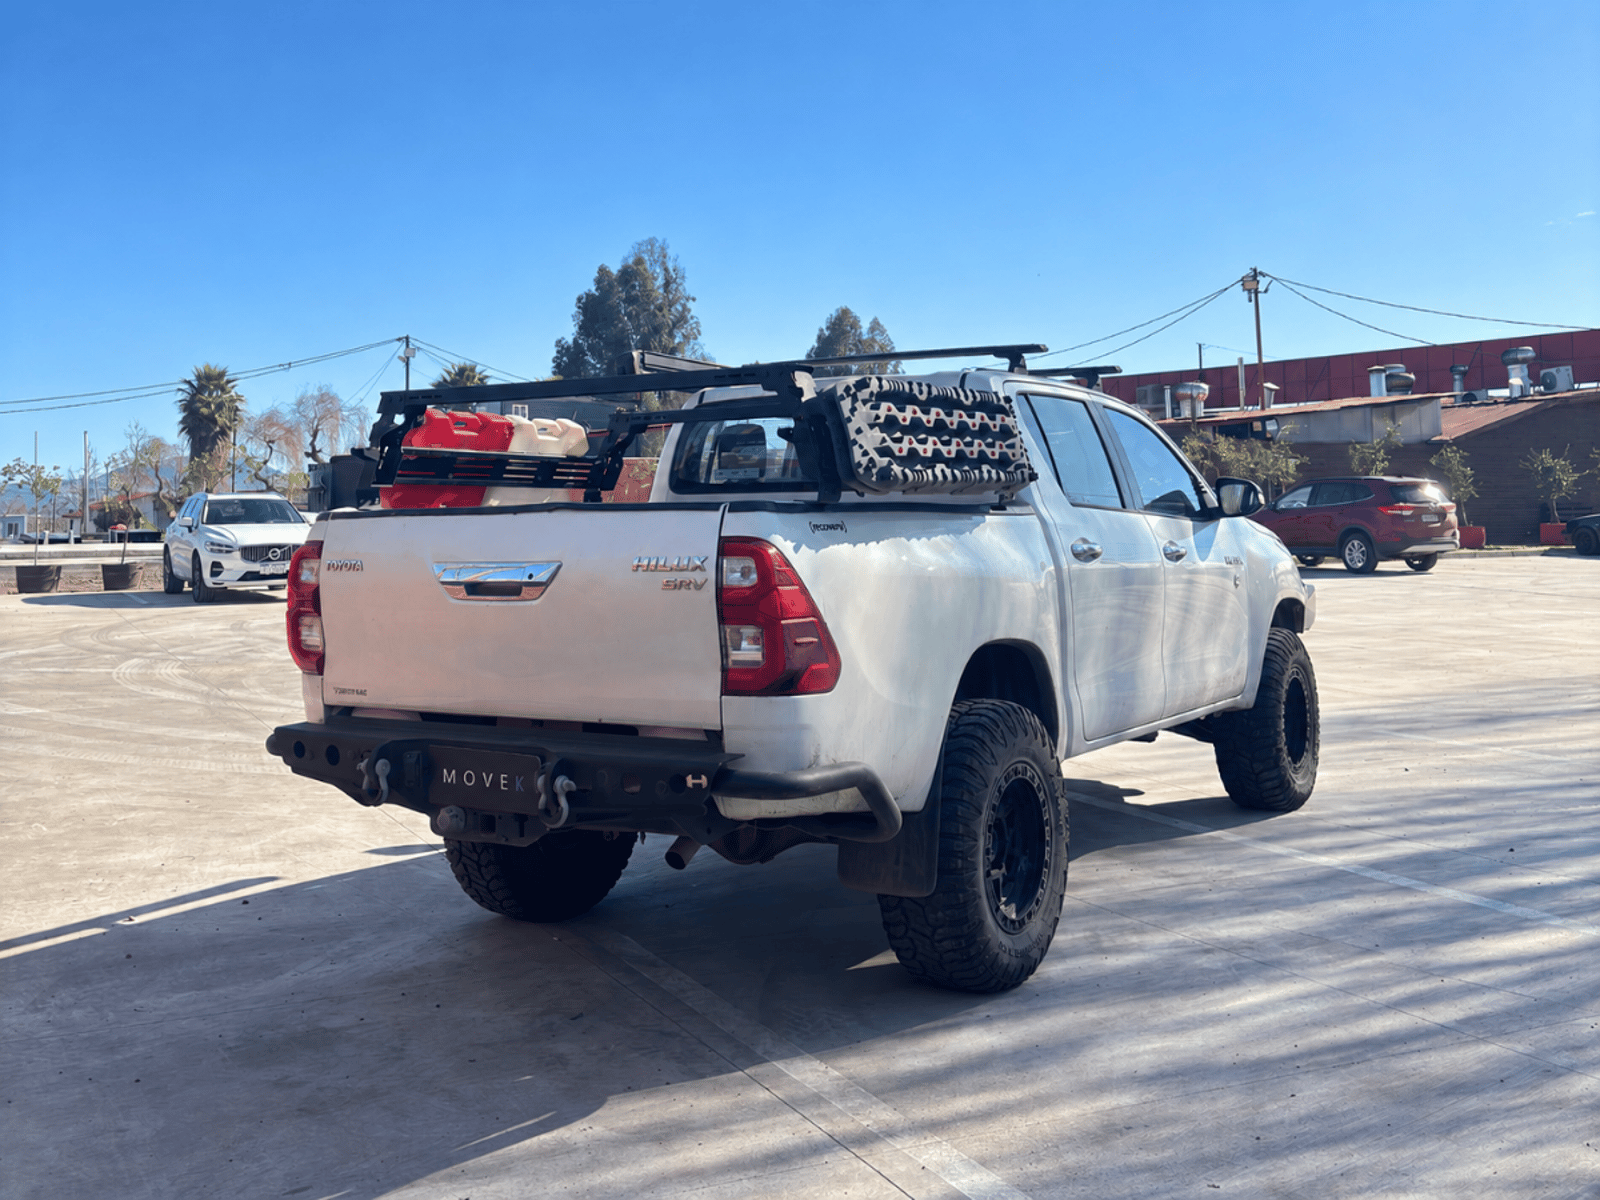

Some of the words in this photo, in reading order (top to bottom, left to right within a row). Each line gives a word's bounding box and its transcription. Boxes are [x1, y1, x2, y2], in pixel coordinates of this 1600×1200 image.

[326, 559, 364, 571] TOYOTA
[631, 556, 708, 572] HILUX
[661, 578, 708, 591] SRV
[443, 768, 524, 792] MOVEK
